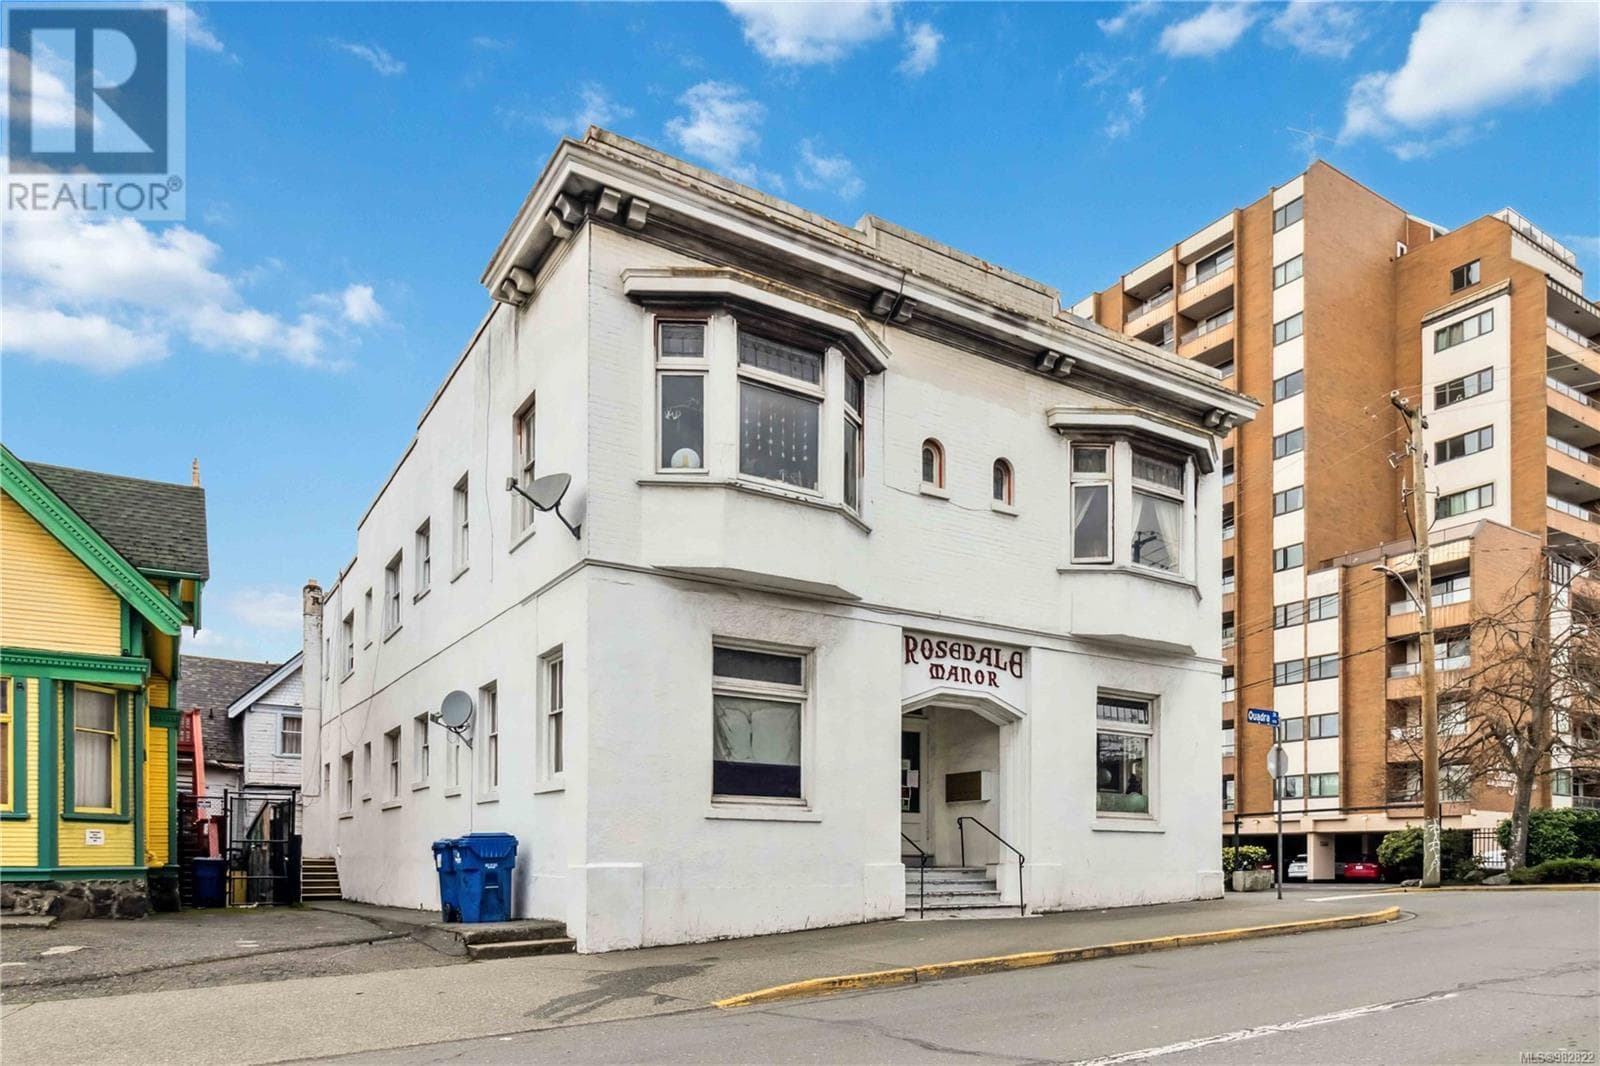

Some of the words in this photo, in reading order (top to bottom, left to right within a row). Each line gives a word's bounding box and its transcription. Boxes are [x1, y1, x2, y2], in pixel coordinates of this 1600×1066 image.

[903, 634, 1024, 680] ROSEDALE
[929, 662, 1000, 688] MANOR
[1248, 710, 1271, 723] Quadra
